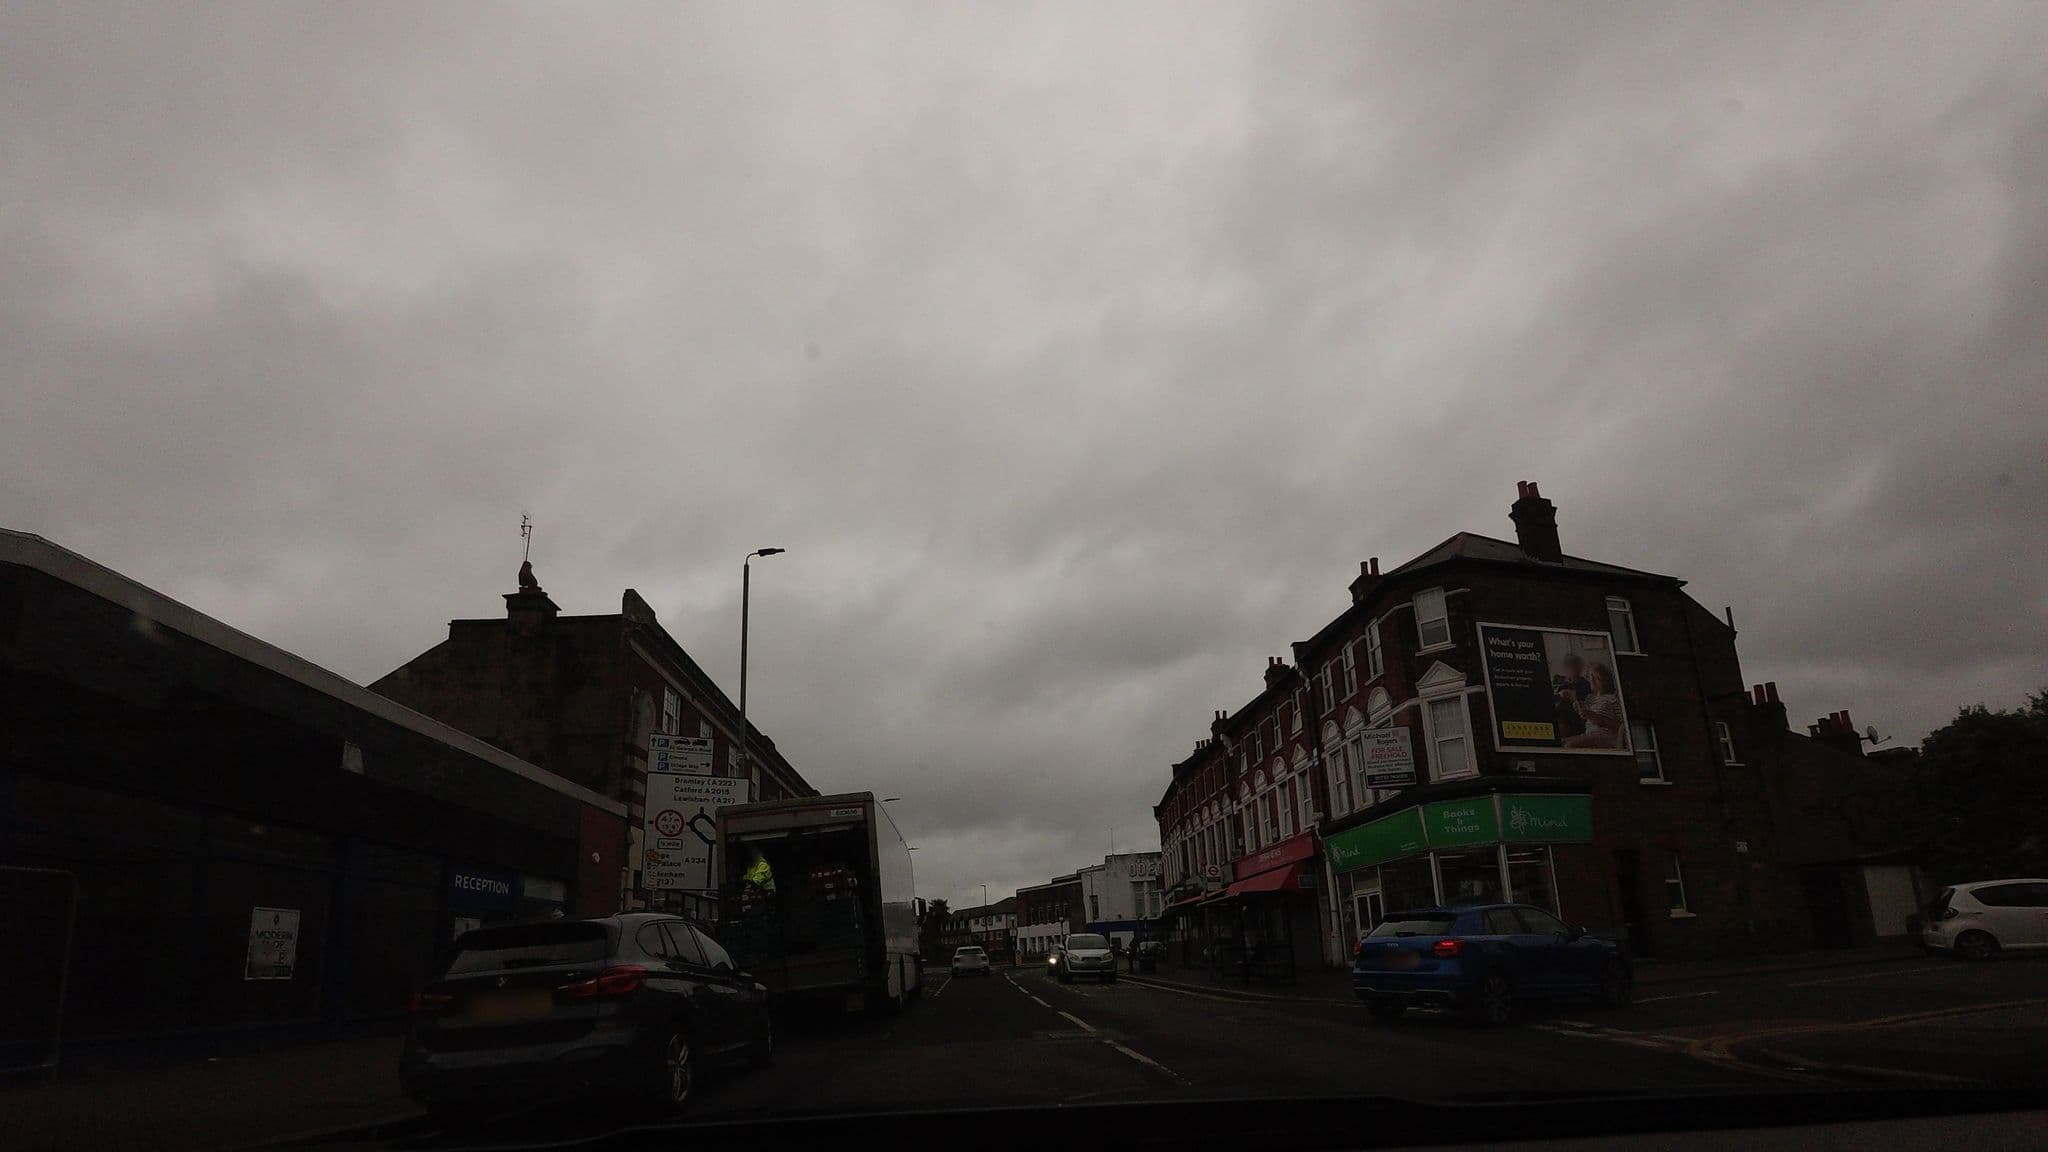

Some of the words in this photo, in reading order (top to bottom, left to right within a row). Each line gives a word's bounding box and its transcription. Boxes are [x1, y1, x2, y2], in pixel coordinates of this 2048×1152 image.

[1488, 636, 1516, 648] What's
[1518, 640, 1534, 650] your
[1491, 649, 1514, 660] home
[1515, 651, 1541, 662] worth?
[1371, 751, 1407, 760] FREEHOLD
[674, 777, 705, 786] Bromley
[707, 779, 737, 787] (A222)
[673, 786, 703, 794] Catford
[712, 797, 736, 805] (A21)
[1442, 809, 1475, 819] Books
[1443, 823, 1480, 833] Things
[1128, 862, 1163, 878] ODEO
[455, 874, 511, 895] RECEPTION
